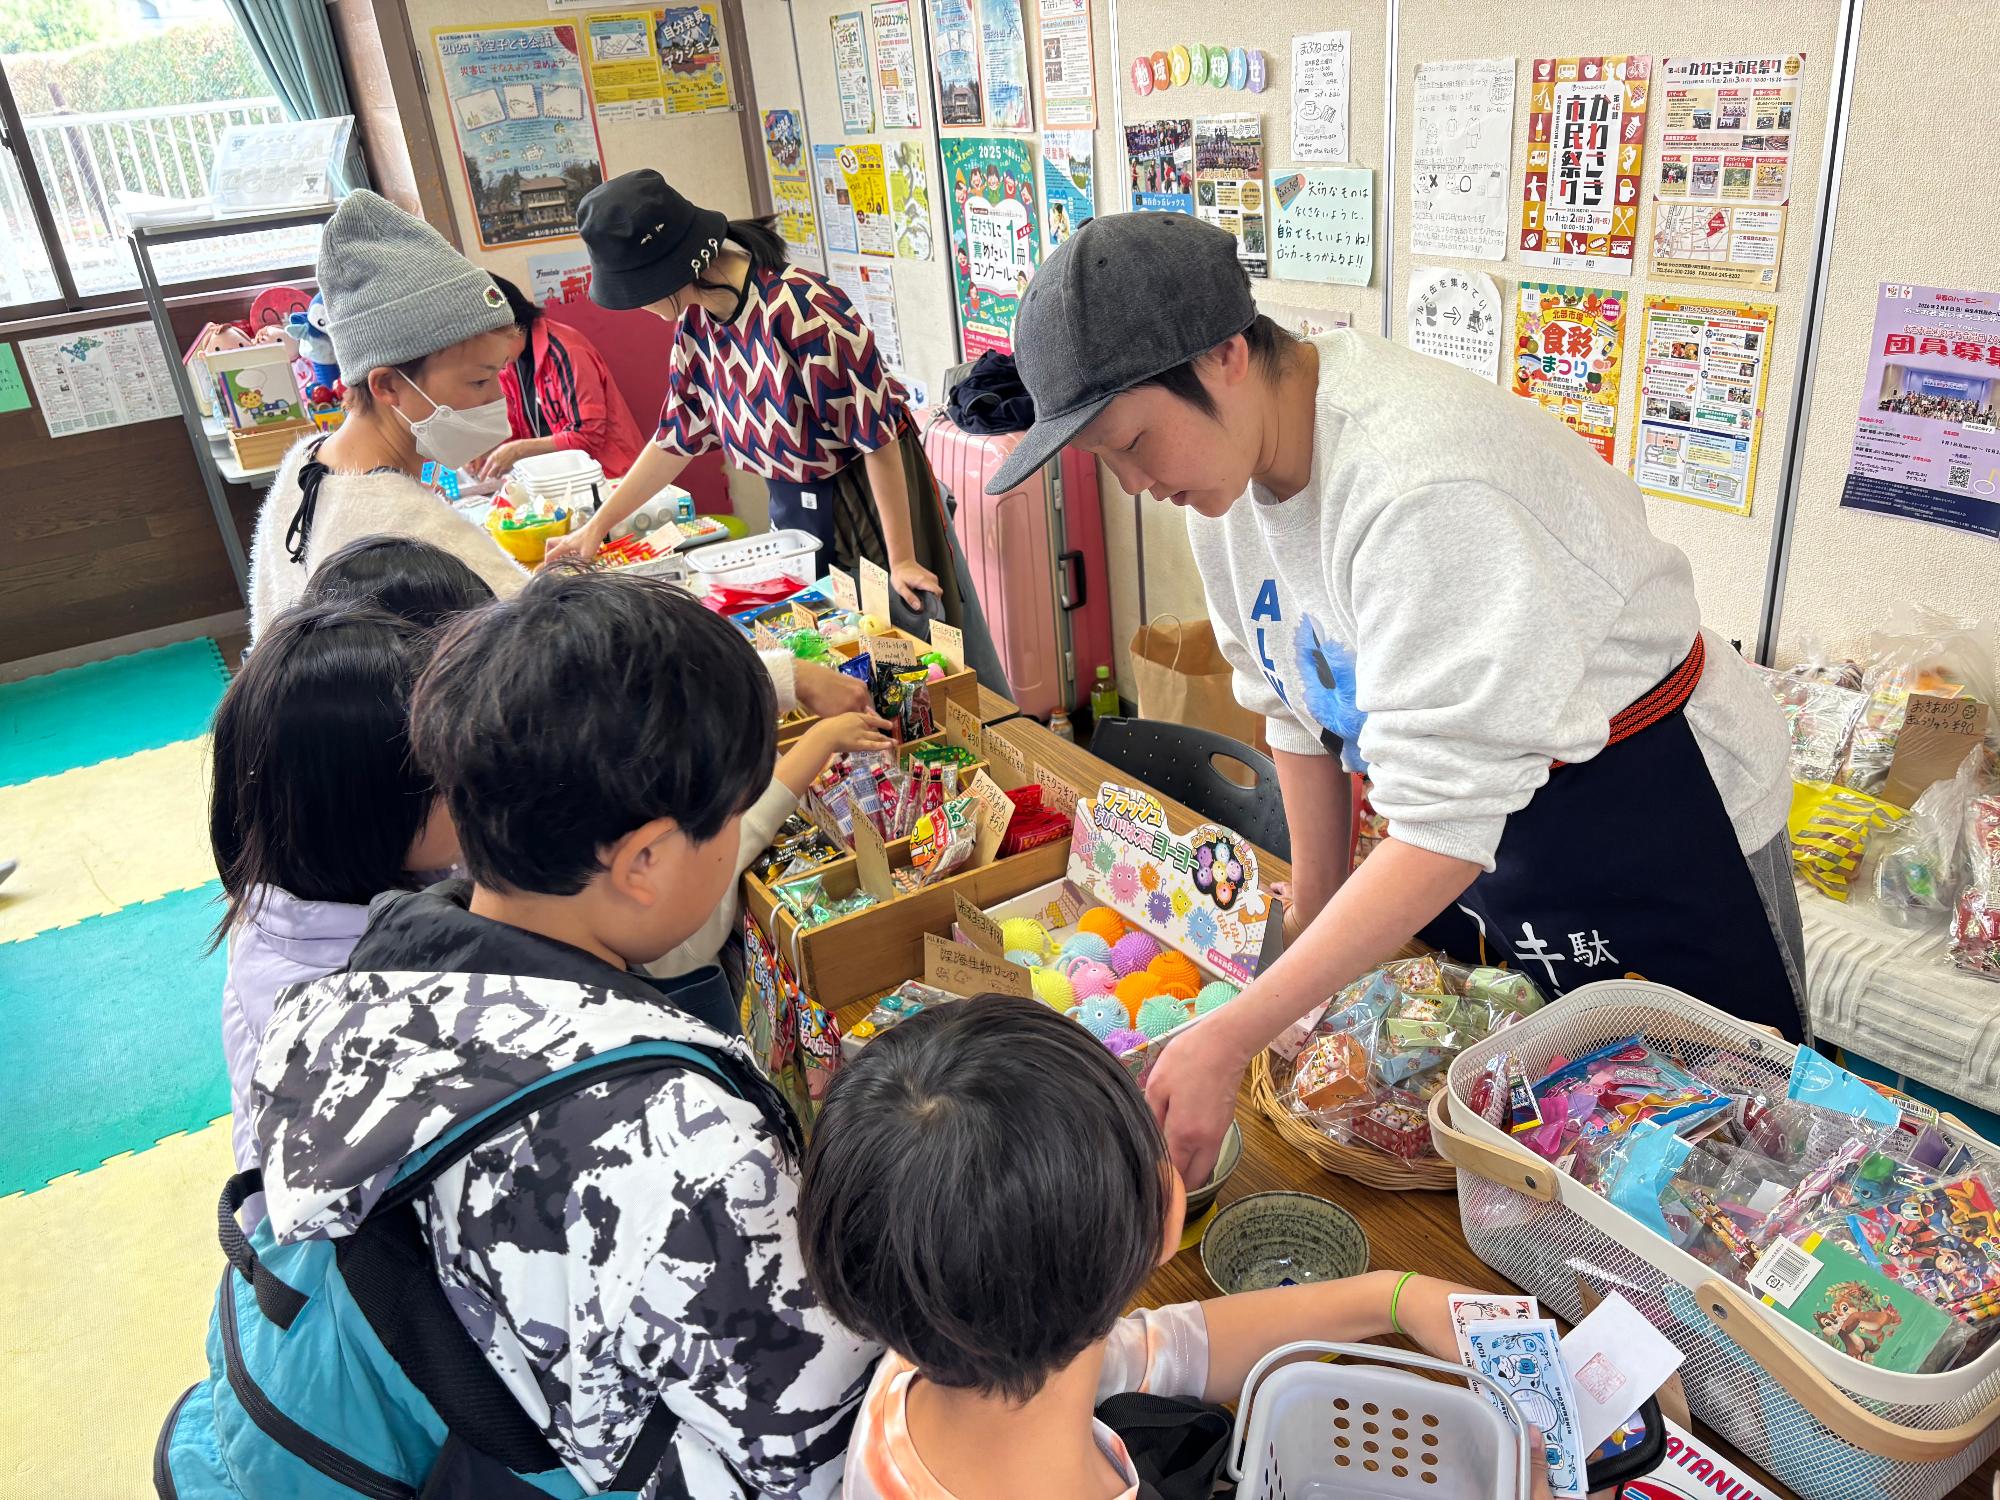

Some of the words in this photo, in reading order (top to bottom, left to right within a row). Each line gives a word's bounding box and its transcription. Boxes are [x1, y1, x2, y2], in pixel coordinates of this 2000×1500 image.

[662, 8, 706, 41] 自分発見
[664, 34, 715, 69] アクション
[1133, 45, 1263, 95] 地域のお知らせ
[1688, 59, 1782, 76] かわさき市民祭り
[978, 145, 1002, 159] 2025
[1559, 94, 1587, 206] 市民祭り
[1583, 94, 1611, 206] かわさき
[1308, 184, 1369, 199] 大切なものは
[970, 215, 1002, 238] 友だちに
[1277, 224, 1370, 246] 自分でもっていようね!
[974, 263, 1012, 281] コンクール
[1552, 309, 1584, 321] 北部市場
[1541, 321, 1594, 360] 食彩
[1542, 355, 1588, 379] まつり
[1910, 699, 1960, 718] おきあがり
[1905, 714, 1949, 730] きょうりゅう
[1951, 719, 1975, 736] ¥90
[1102, 787, 1164, 828] フラッシュ
[989, 812, 1005, 834] ¥50
[1567, 929, 1620, 968] 駄
[1475, 1341, 1487, 1359] 100
[1664, 1430, 1763, 1500] ATANU
